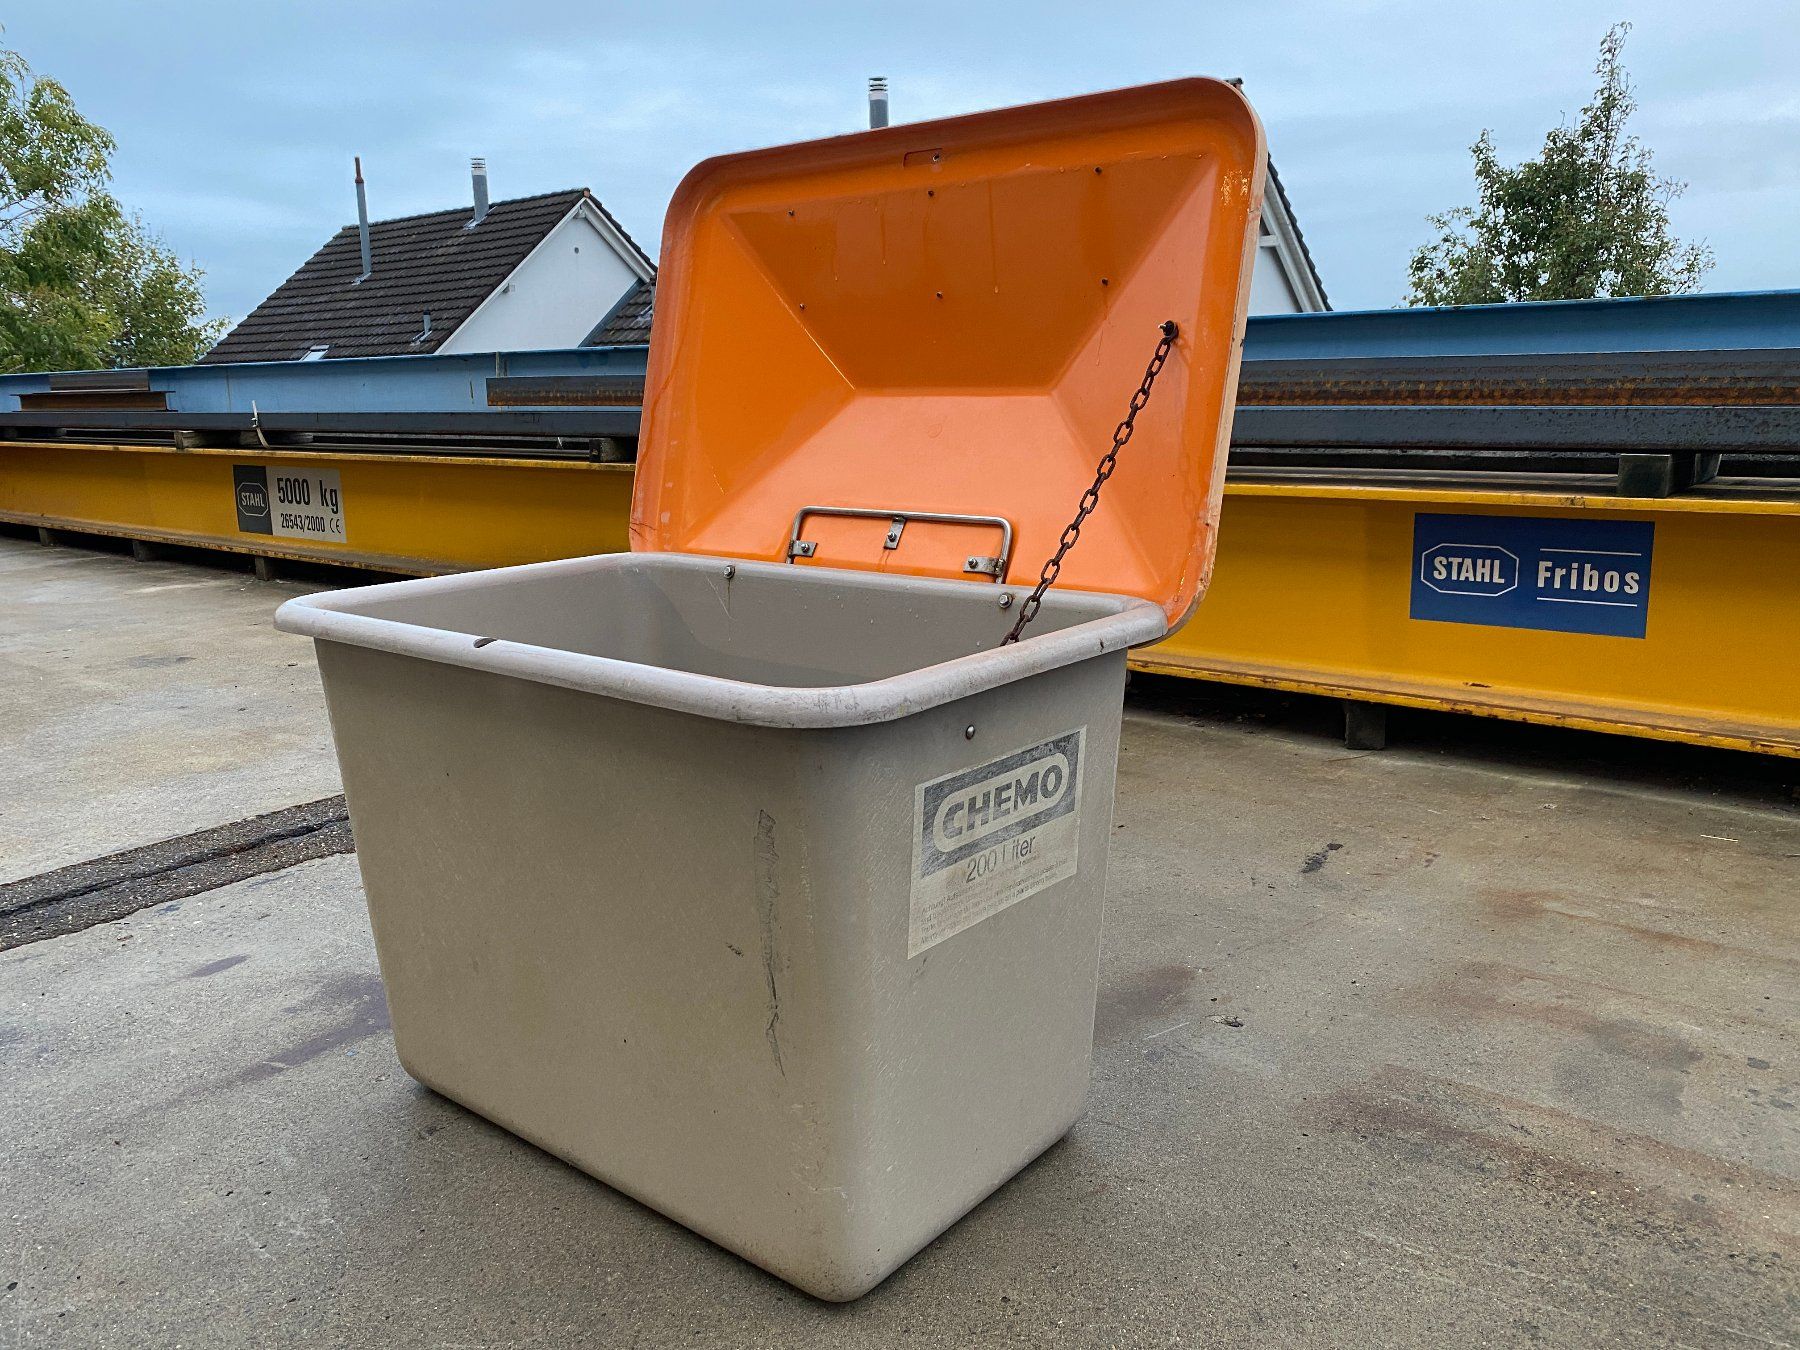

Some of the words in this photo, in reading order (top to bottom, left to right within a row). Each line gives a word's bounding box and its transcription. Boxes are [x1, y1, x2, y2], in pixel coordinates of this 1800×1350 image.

[241, 492, 265, 507] STAHL
[277, 478, 311, 505] 5000
[319, 480, 339, 514] kg
[281, 513, 325, 532] 26543/2000
[1433, 556, 1505, 584] STAHL
[1537, 560, 1640, 595] Fribos
[942, 765, 1063, 839] CHEMO
[965, 848, 998, 884] 200
